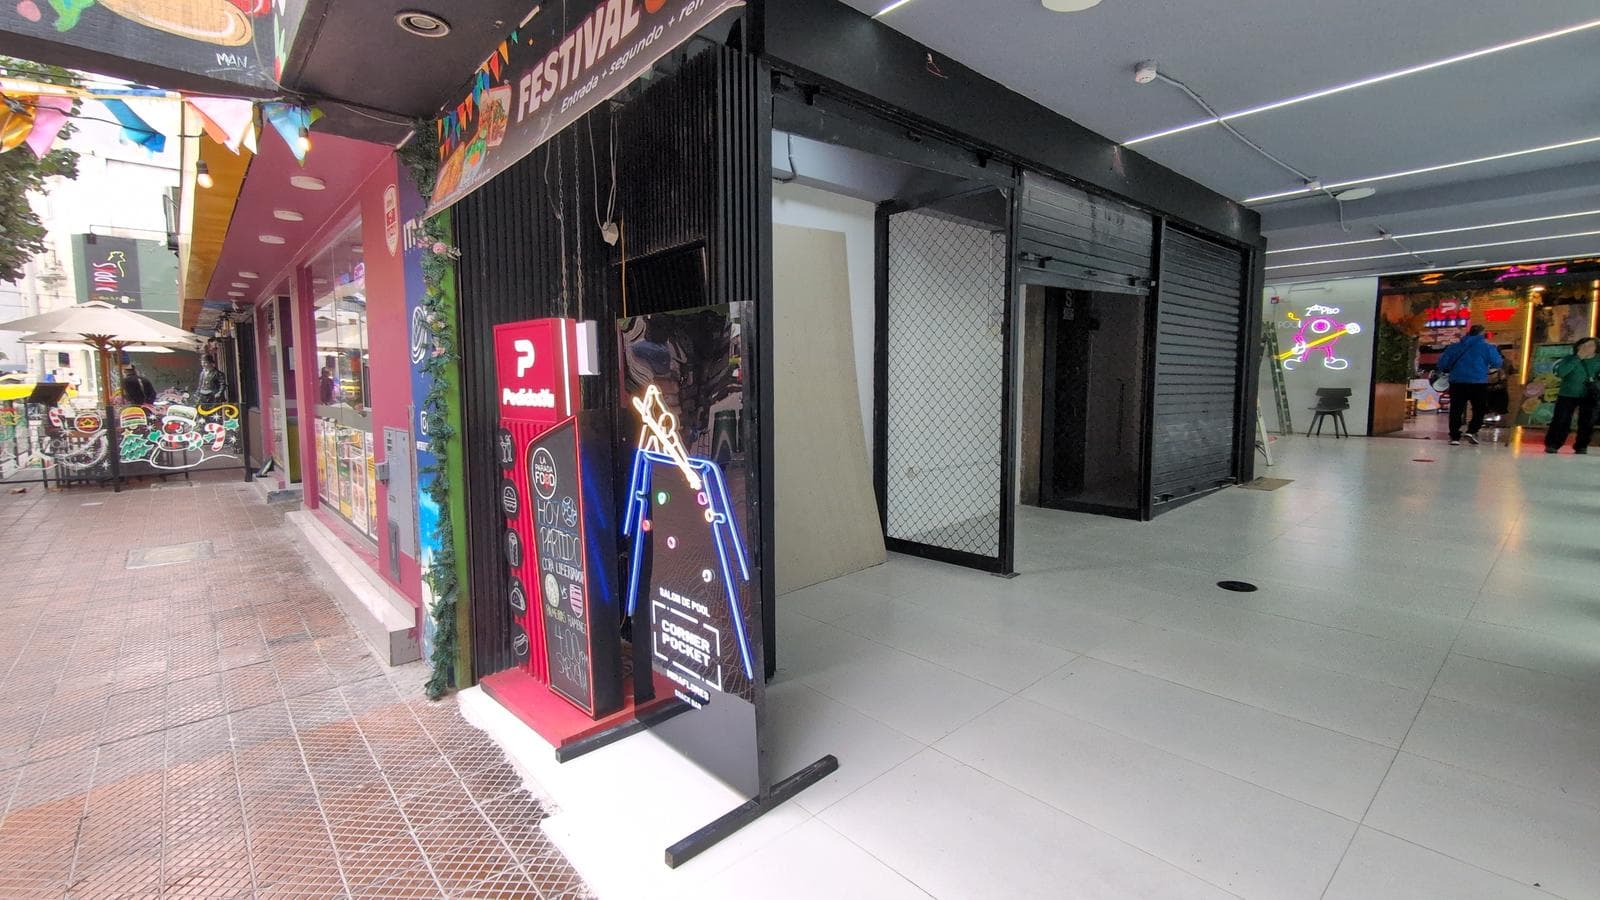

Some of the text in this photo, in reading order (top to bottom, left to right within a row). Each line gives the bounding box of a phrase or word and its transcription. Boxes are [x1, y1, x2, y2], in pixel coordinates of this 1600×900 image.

[216, 52, 247, 68] MAN
[517, 0, 640, 123] FESTIVAL
[560, 74, 599, 113] Entrada
[608, 24, 664, 75] segundo
[537, 499, 560, 528] HOY
[540, 527, 582, 568] PARTIDO
[681, 596, 691, 609] DE
[691, 600, 711, 618] POOL
[661, 619, 710, 654] CORNER
[662, 631, 711, 667] POCKET
